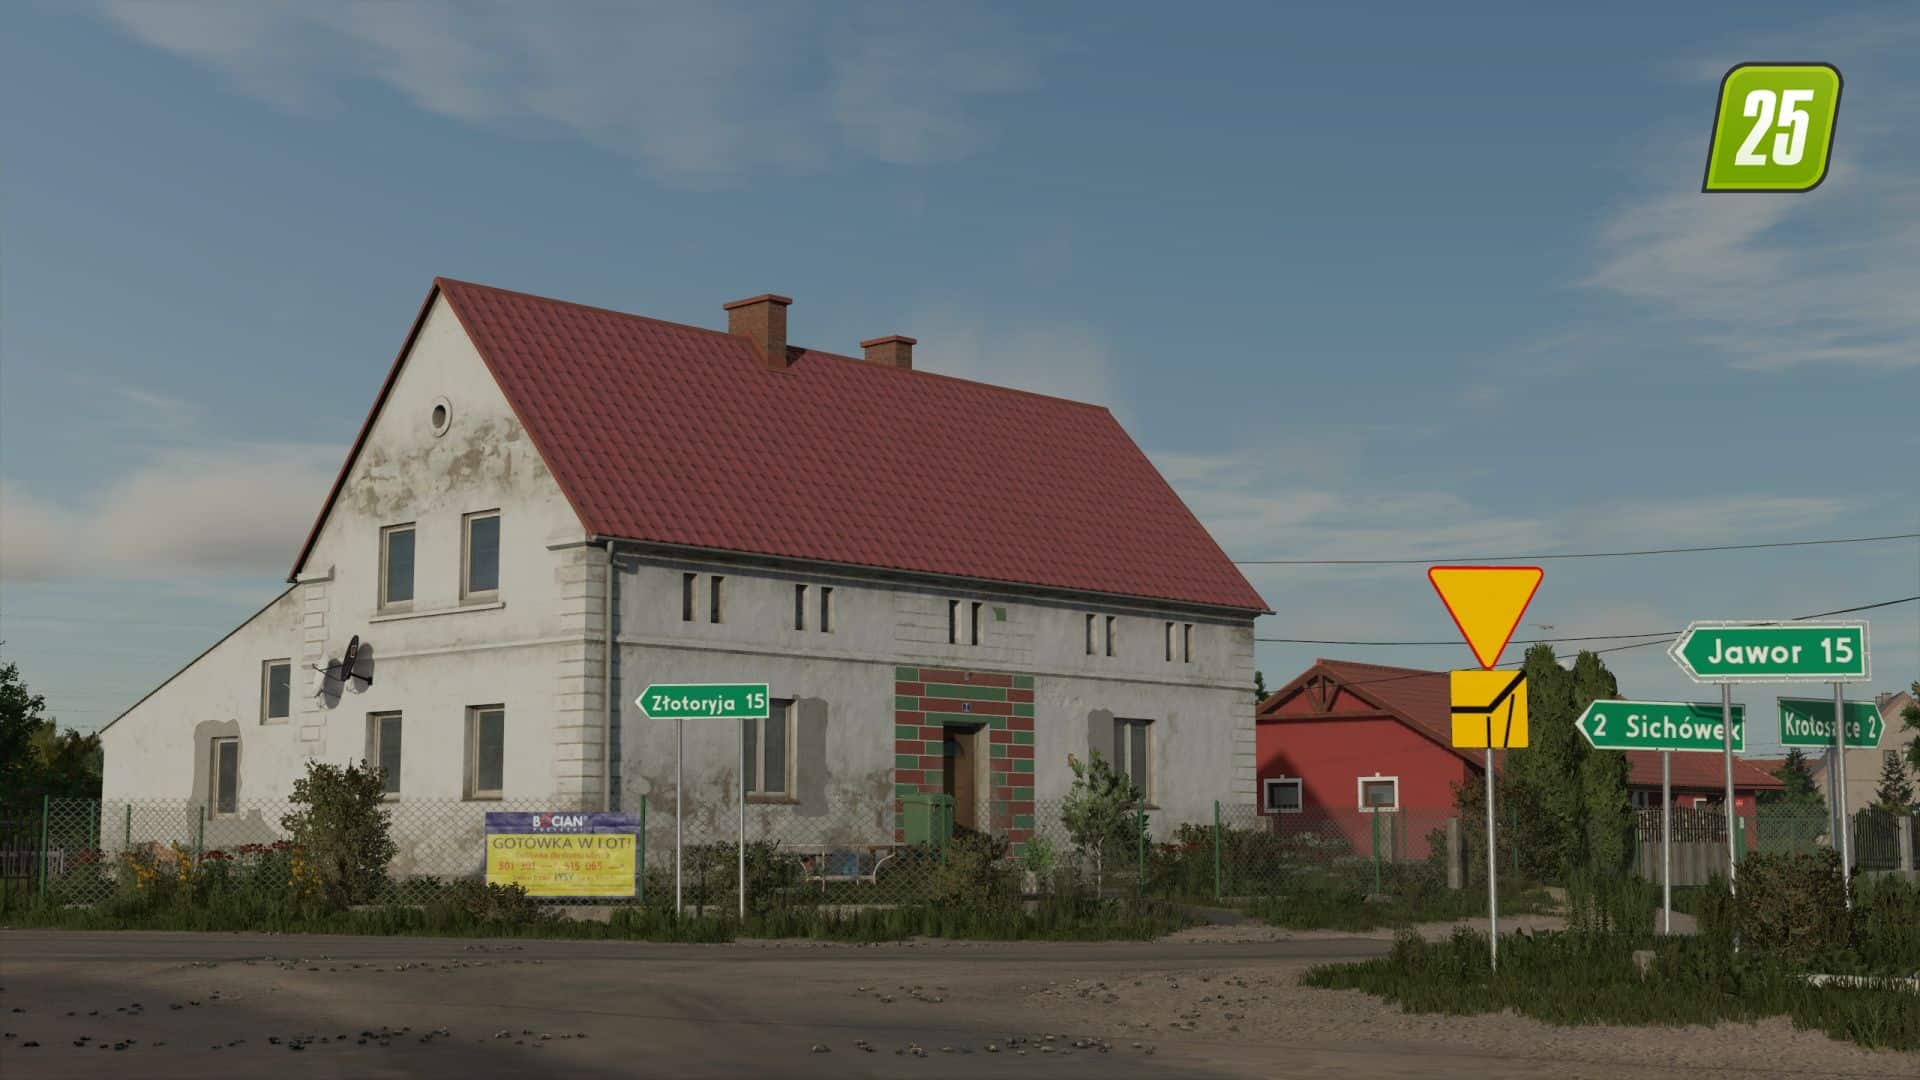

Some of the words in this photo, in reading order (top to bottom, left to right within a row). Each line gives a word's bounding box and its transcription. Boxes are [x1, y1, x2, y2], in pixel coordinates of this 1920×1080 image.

[1707, 637, 1803, 665] Jawor
[1820, 636, 1854, 664] 15
[651, 694, 736, 716] Złotoryja
[745, 692, 766, 710] 15
[1592, 713, 1607, 737] 2
[1625, 714, 1741, 741] Sichówek
[1785, 711, 1861, 738] Krotoszce
[1867, 714, 1877, 739] 2
[492, 836, 574, 850] GOTÓWKA
[578, 837, 595, 849] W
